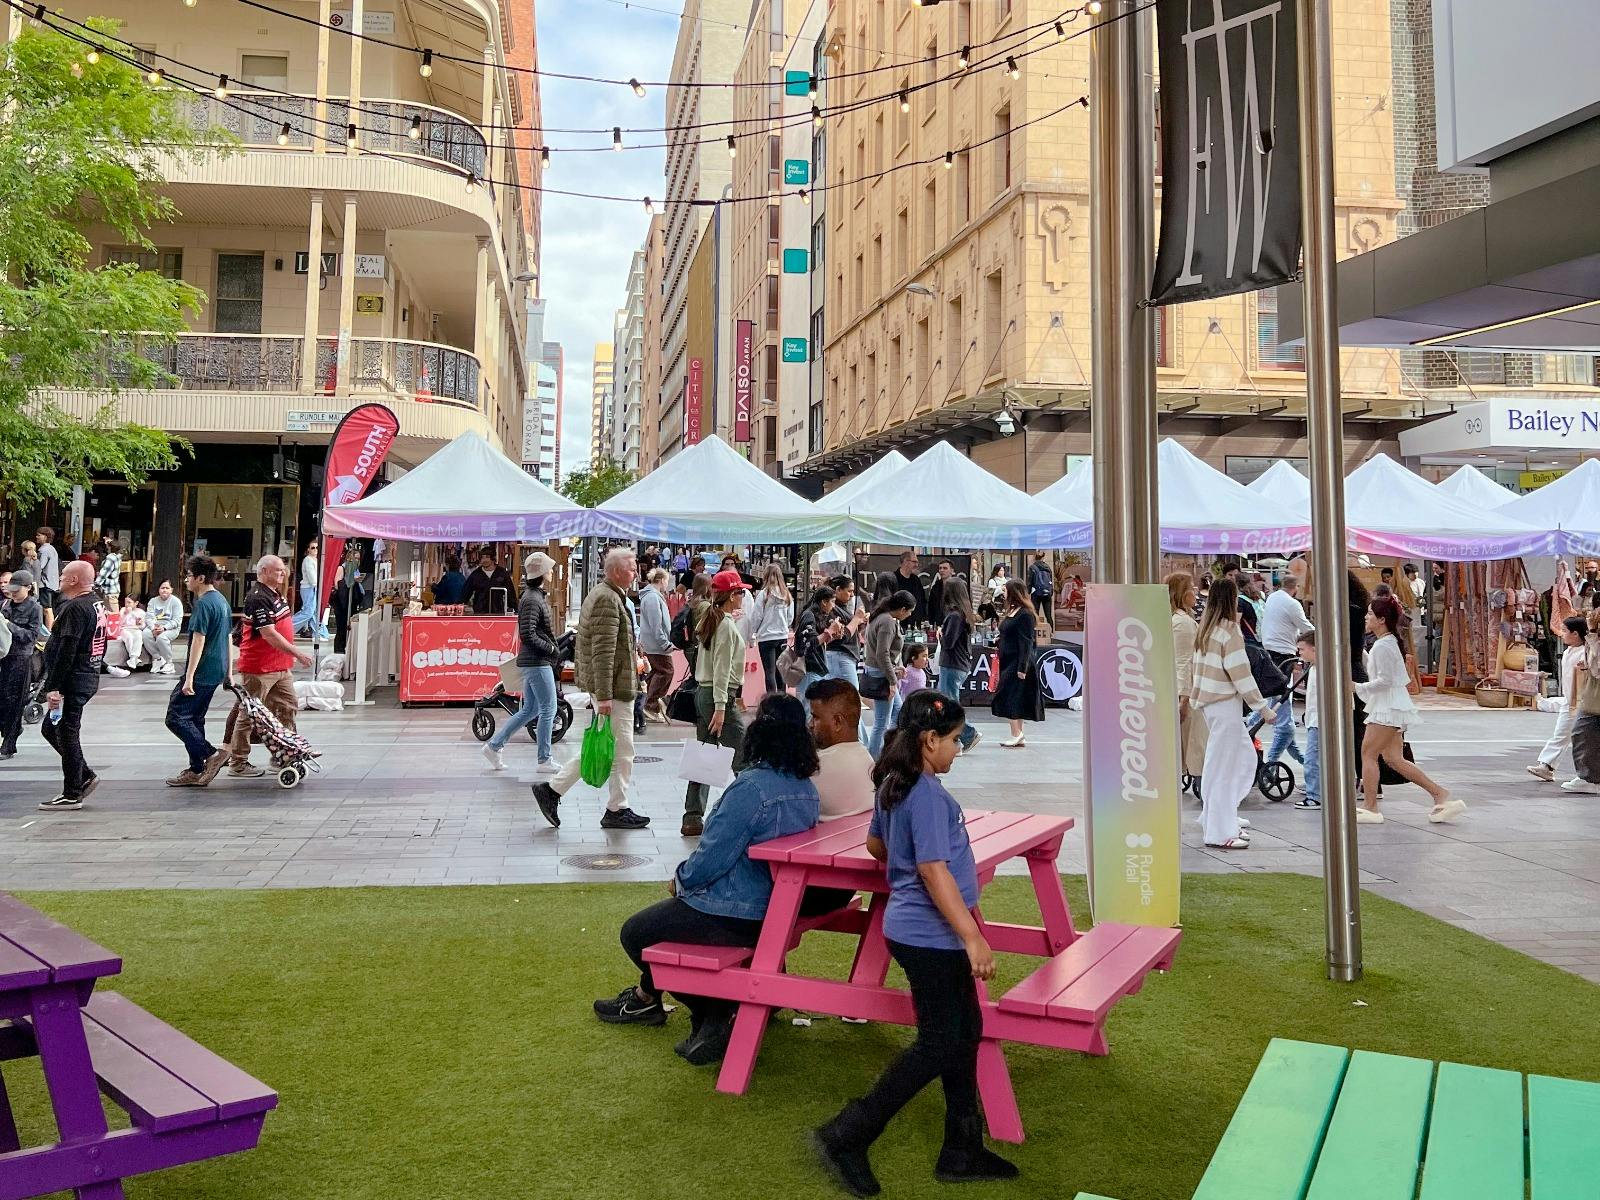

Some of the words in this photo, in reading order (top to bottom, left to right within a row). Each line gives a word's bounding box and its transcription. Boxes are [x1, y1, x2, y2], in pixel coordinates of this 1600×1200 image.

[300, 413, 325, 421] RUNDLE
[532, 401, 540, 435] BRIDAL
[1507, 409, 1576, 437] Bailey
[353, 424, 387, 477] SOUTH
[524, 419, 533, 459] FORMAL
[396, 523, 407, 534] in
[411, 523, 434, 536] the
[438, 523, 464, 537] Mall
[1067, 529, 1092, 542] Mar
[1160, 534, 1174, 547] all
[1447, 543, 1458, 555] in
[1461, 543, 1480, 556] the
[1117, 616, 1159, 802] Gathered
[1125, 854, 1139, 884] Mall
[1140, 854, 1154, 906] Rundle
